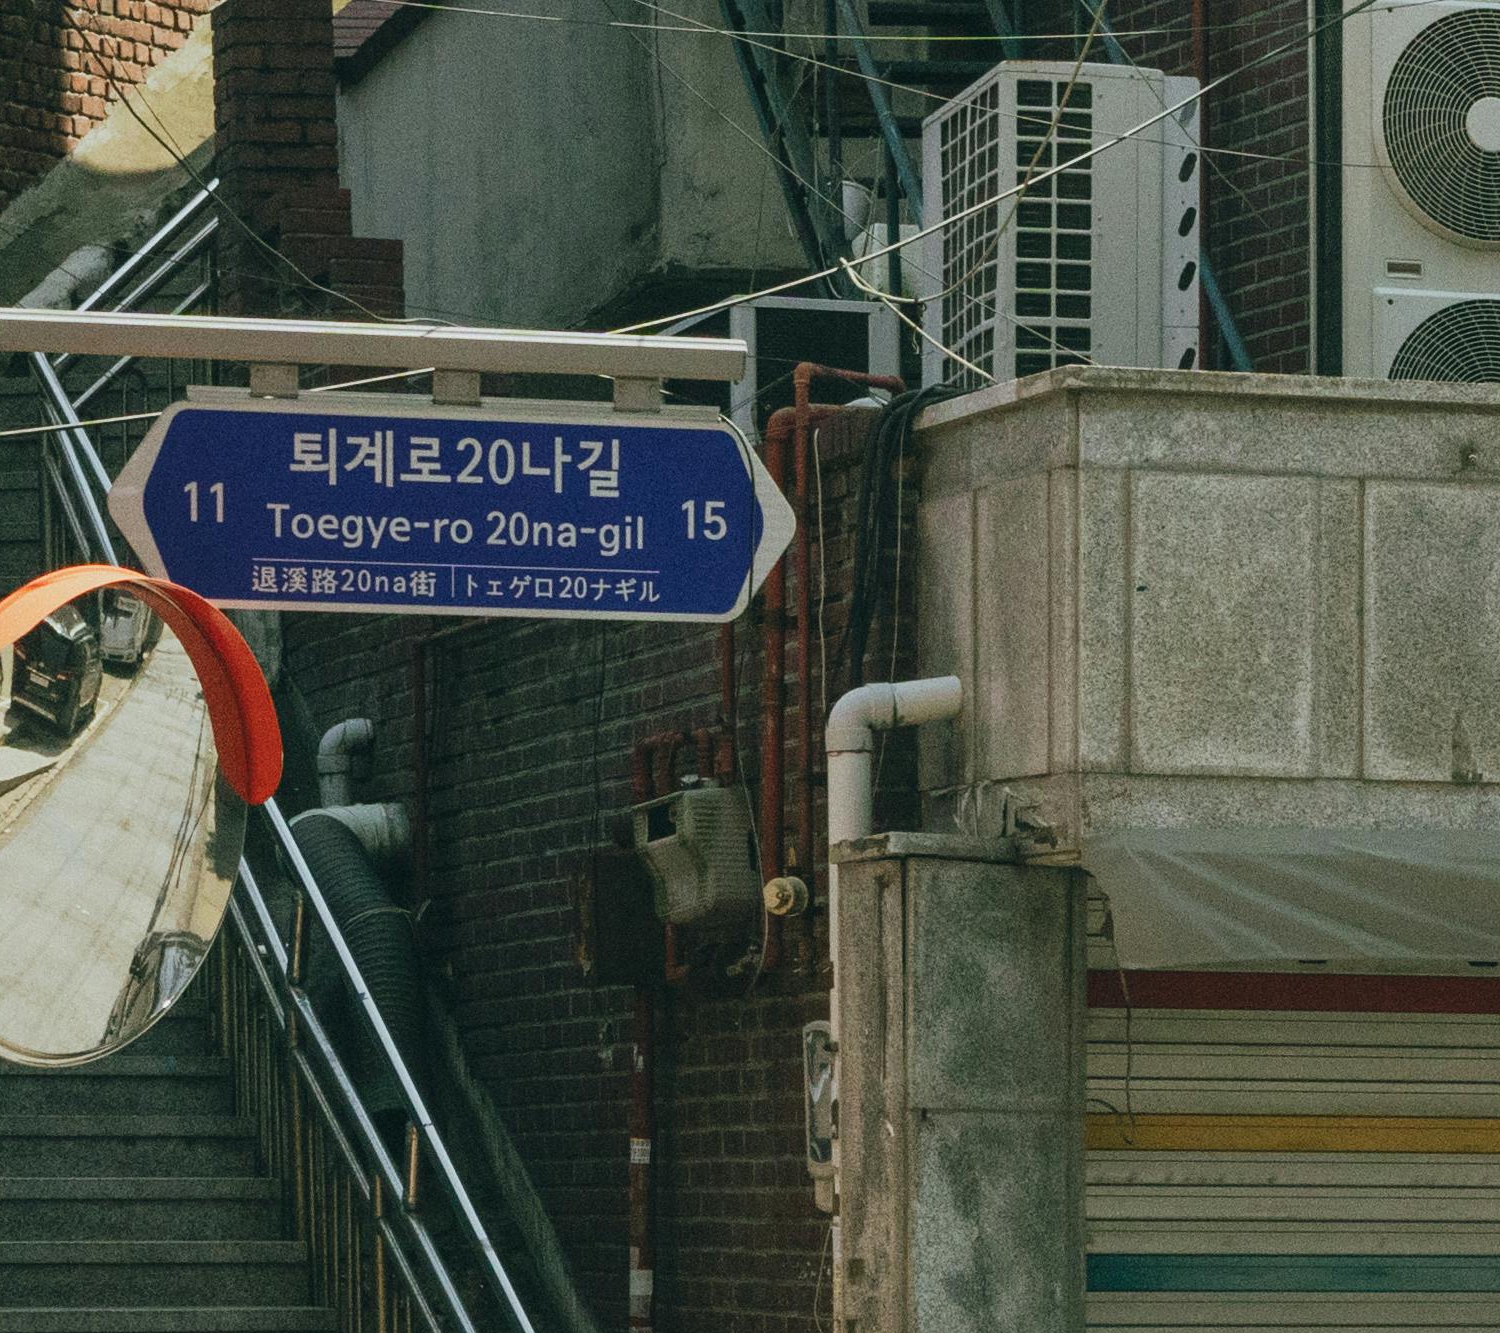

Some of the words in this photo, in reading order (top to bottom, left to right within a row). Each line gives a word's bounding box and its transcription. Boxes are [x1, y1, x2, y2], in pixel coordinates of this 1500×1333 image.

[289, 428, 620, 497] 퇴계로20나길
[184, 481, 225, 523] 11
[680, 500, 727, 540] 15
[266, 503, 473, 548] Toegye-ro
[486, 511, 644, 555] 20na-gil
[251, 565, 436, 598] 退溪路20na街
